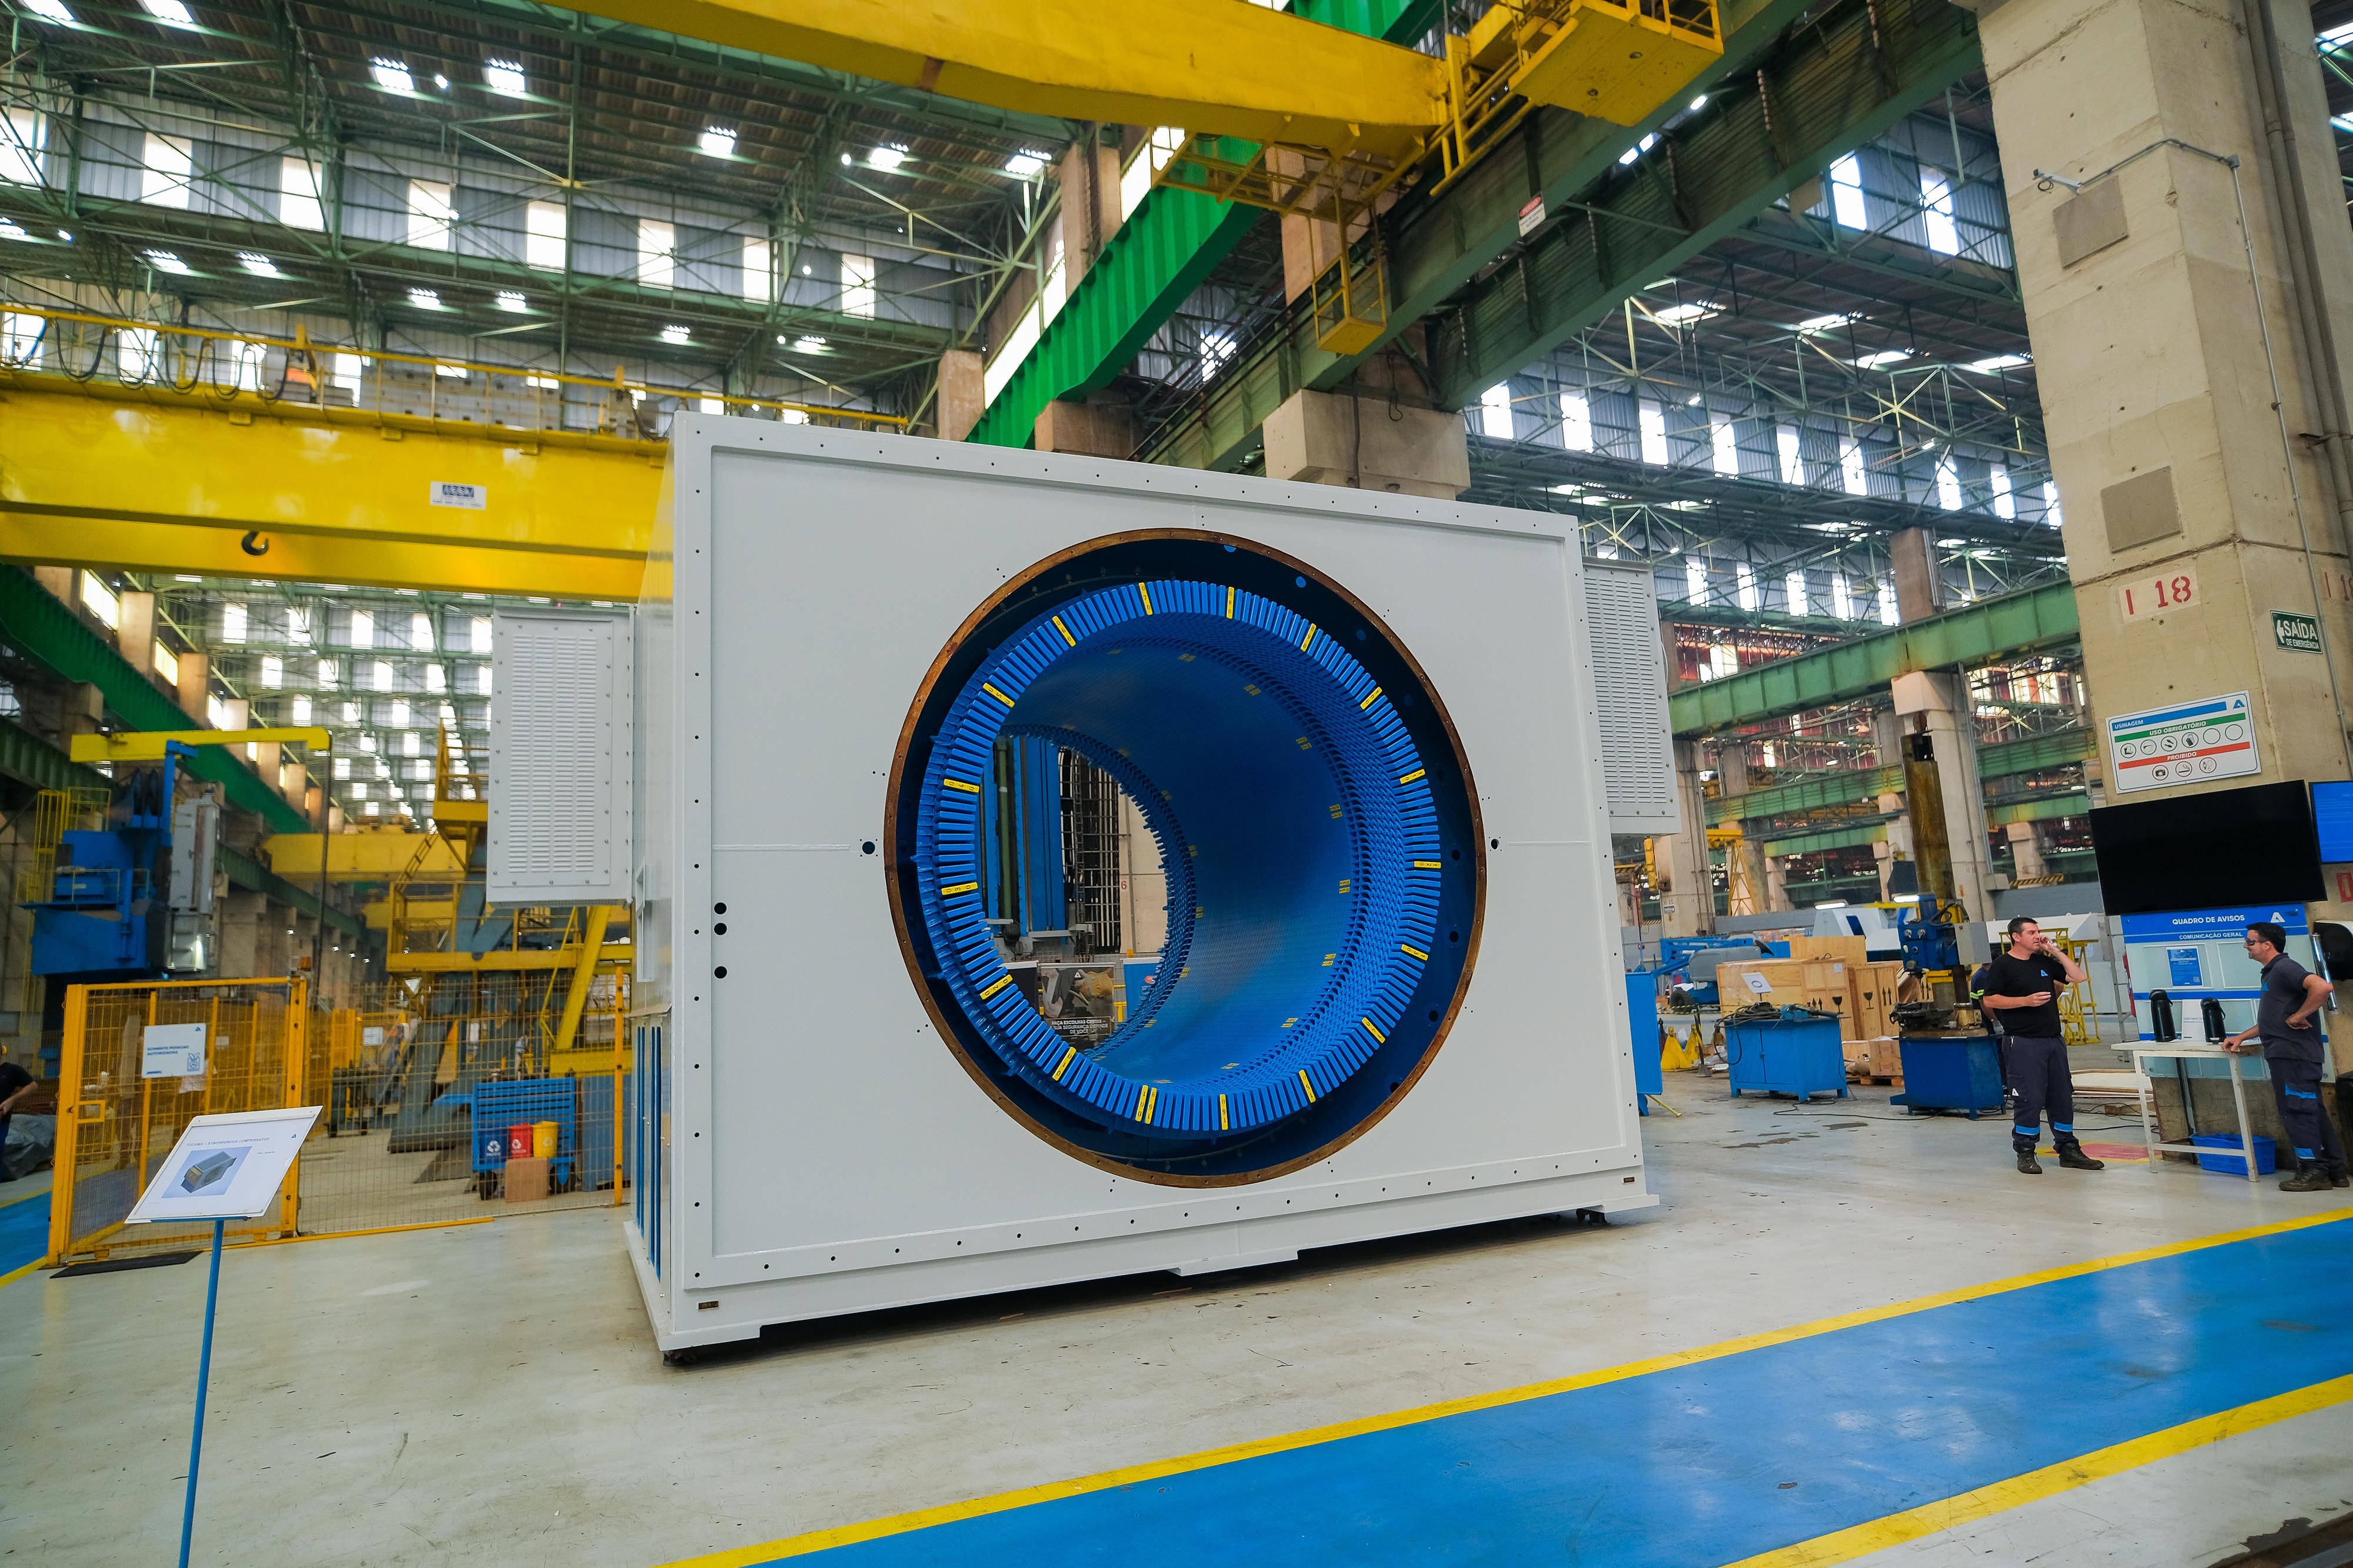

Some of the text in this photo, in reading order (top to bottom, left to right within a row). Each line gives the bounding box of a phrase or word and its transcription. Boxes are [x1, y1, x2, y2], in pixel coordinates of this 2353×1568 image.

[2155, 576, 2191, 608] 18
[2283, 619, 2318, 640] SAÍDA
[2292, 639, 2319, 649] EMERGÊNCIA
[2114, 719, 2144, 729] USINAGEM
[2164, 721, 2207, 733] OBRIGATÓRIO
[2167, 752, 2197, 760] PROIBIDO
[1121, 881, 1127, 890] 6
